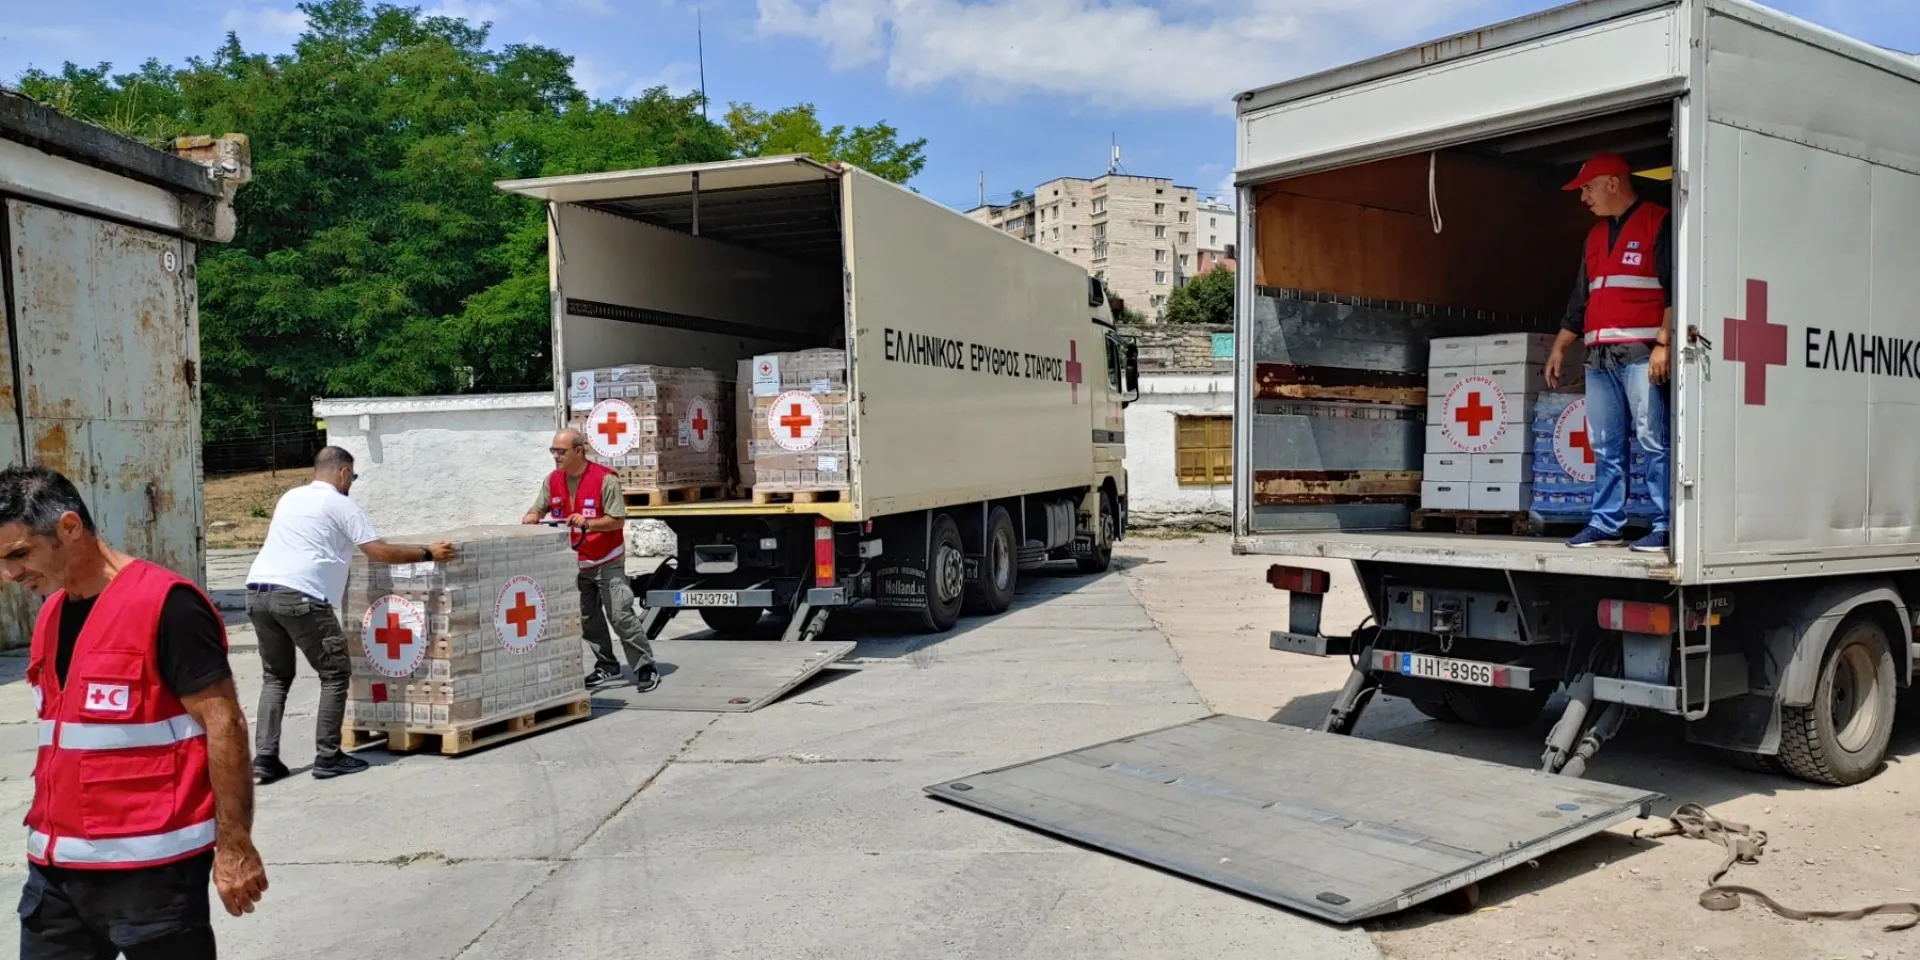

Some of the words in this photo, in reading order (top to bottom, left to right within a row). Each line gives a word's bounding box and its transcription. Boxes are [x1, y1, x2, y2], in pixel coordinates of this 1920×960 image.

[166, 254, 173, 269] 9
[884, 328, 965, 370] ΕΛΛΗΝΙΚΟΣ
[970, 343, 1020, 377] ΕΡΥΘΡΟΣ
[1024, 353, 1063, 381] ΣΤΑΥΡΟΣ
[885, 579, 916, 595] Holland
